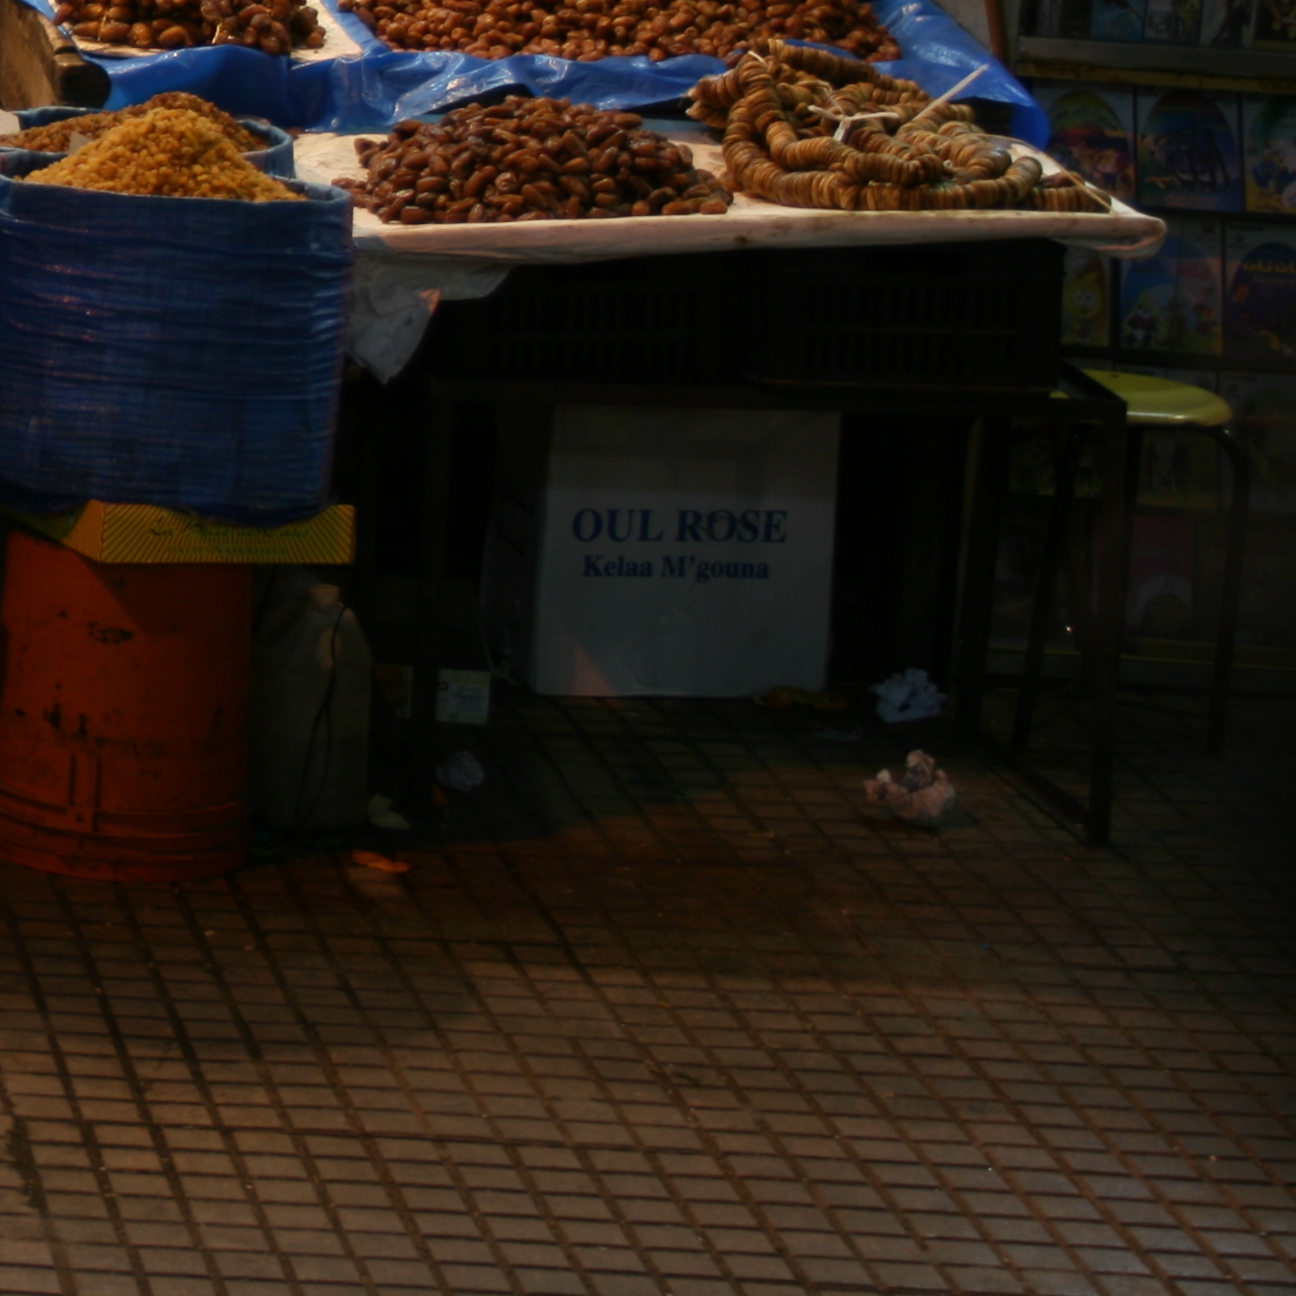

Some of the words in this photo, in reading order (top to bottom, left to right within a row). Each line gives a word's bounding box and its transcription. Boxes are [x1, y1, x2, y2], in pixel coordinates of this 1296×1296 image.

[572, 507, 663, 543] OUL
[674, 508, 788, 544] ROSE
[582, 553, 653, 578] Kelaa
[660, 554, 770, 583] M'gouna
